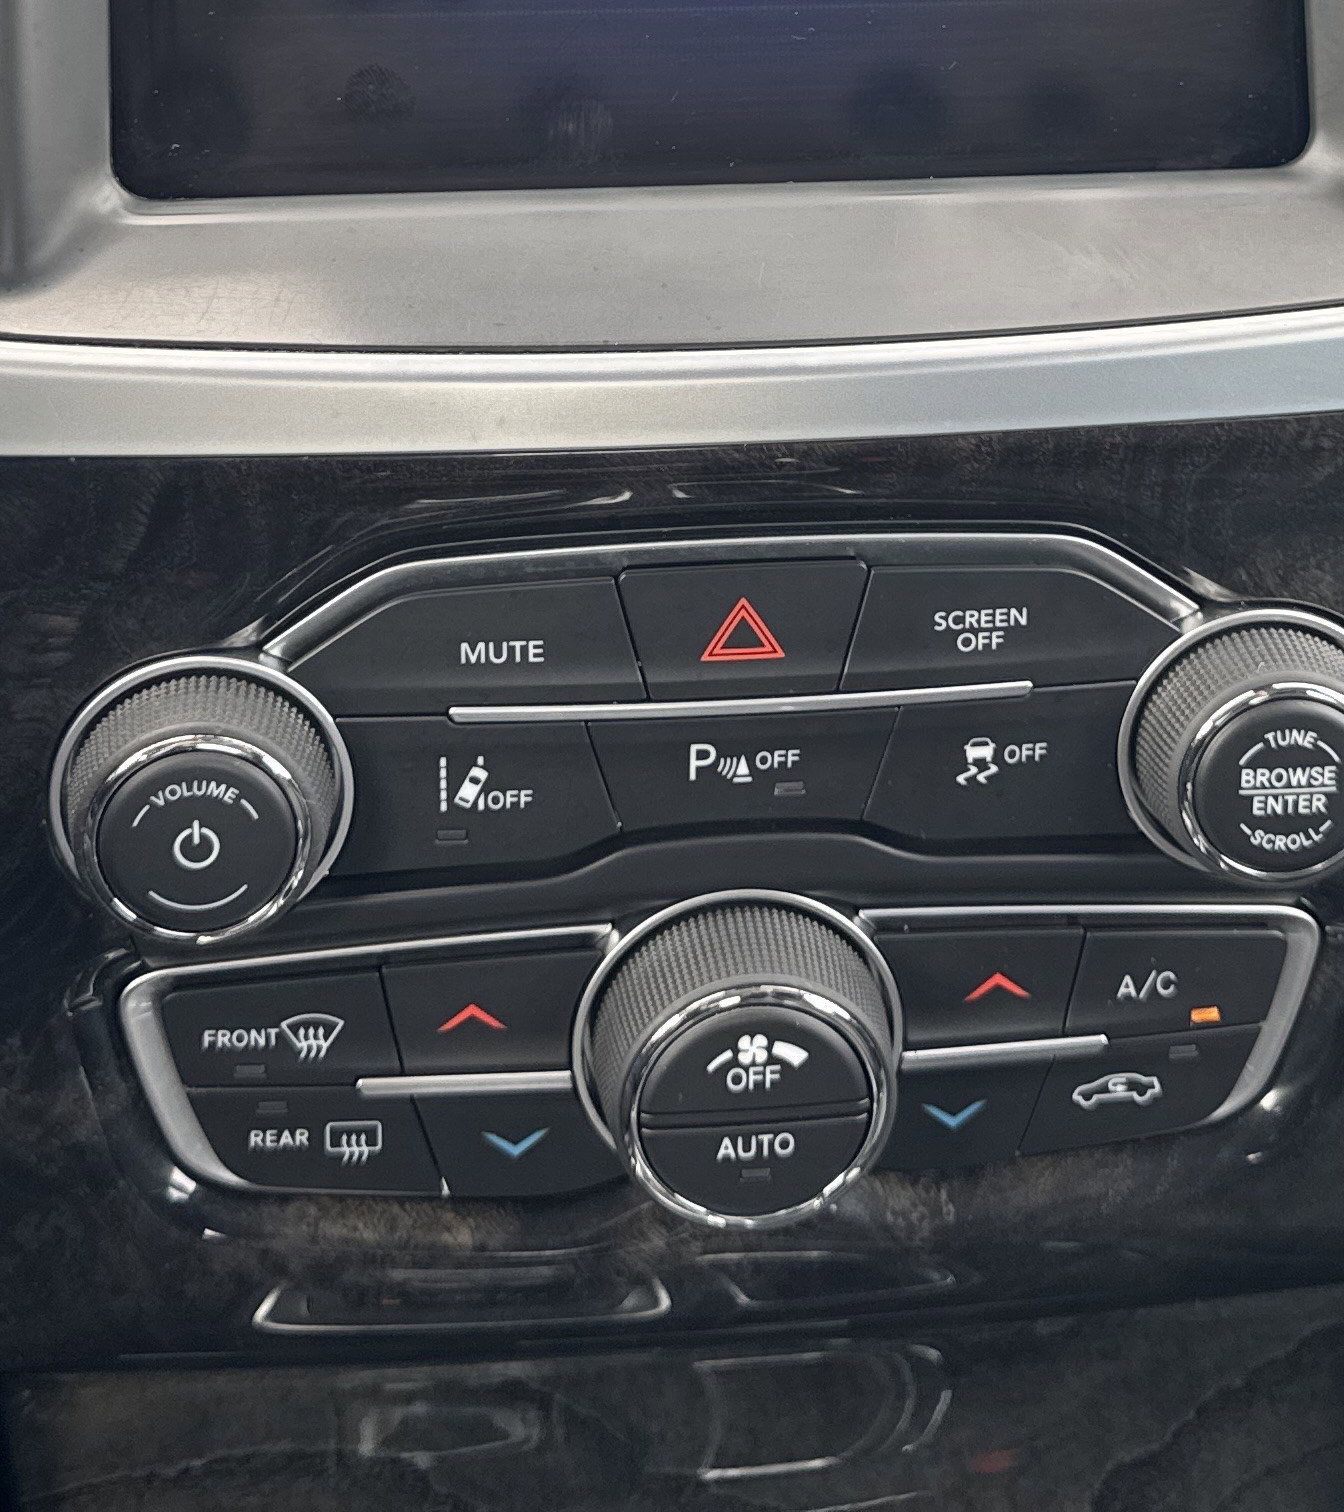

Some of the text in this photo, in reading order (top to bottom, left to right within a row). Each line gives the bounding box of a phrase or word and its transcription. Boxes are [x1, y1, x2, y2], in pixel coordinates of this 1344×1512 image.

[933, 607, 1029, 631] SCREEN
[459, 640, 546, 664] MUTE
[956, 631, 1005, 653] OFF
[1265, 729, 1318, 750] TUNE
[754, 749, 801, 772] OFF
[1002, 742, 1048, 764] OFF
[1239, 765, 1337, 789] BROWSE
[149, 779, 240, 807] VOLUME
[486, 789, 534, 811] OFF
[1251, 792, 1328, 816] ENTER
[1248, 827, 1324, 851] SCROLL
[1116, 970, 1178, 1001] A/C
[202, 1027, 279, 1049] FRONT
[725, 1064, 781, 1093] OFF
[248, 1127, 309, 1149] REAR
[716, 1131, 795, 1160] AUTO
